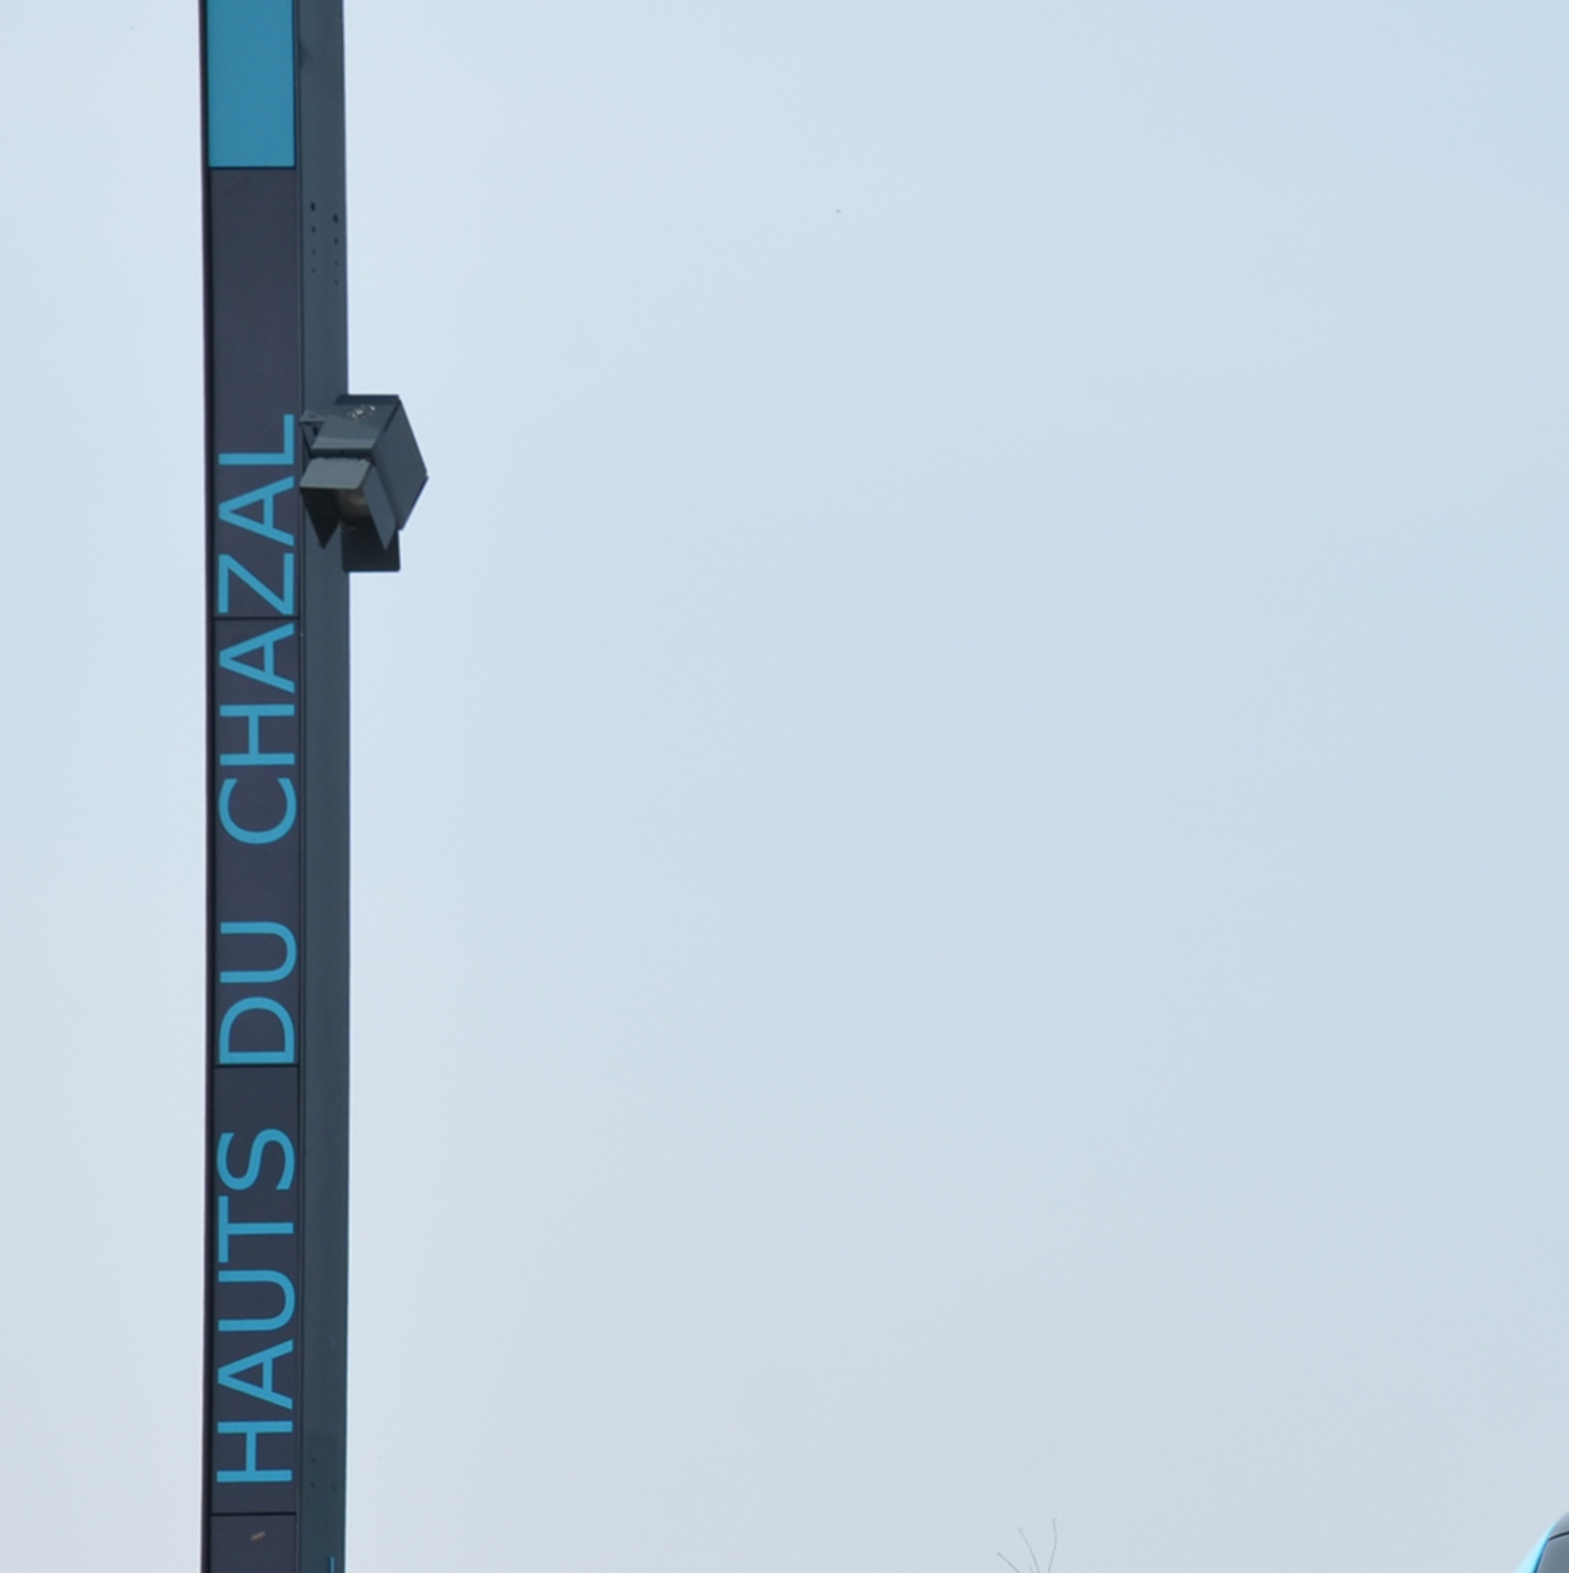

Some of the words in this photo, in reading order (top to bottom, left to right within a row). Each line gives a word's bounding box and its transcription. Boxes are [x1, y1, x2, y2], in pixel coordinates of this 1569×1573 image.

[216, 412, 297, 845] CHAZAL
[217, 921, 298, 1065] DU
[216, 1127, 297, 1484] HAUTS
